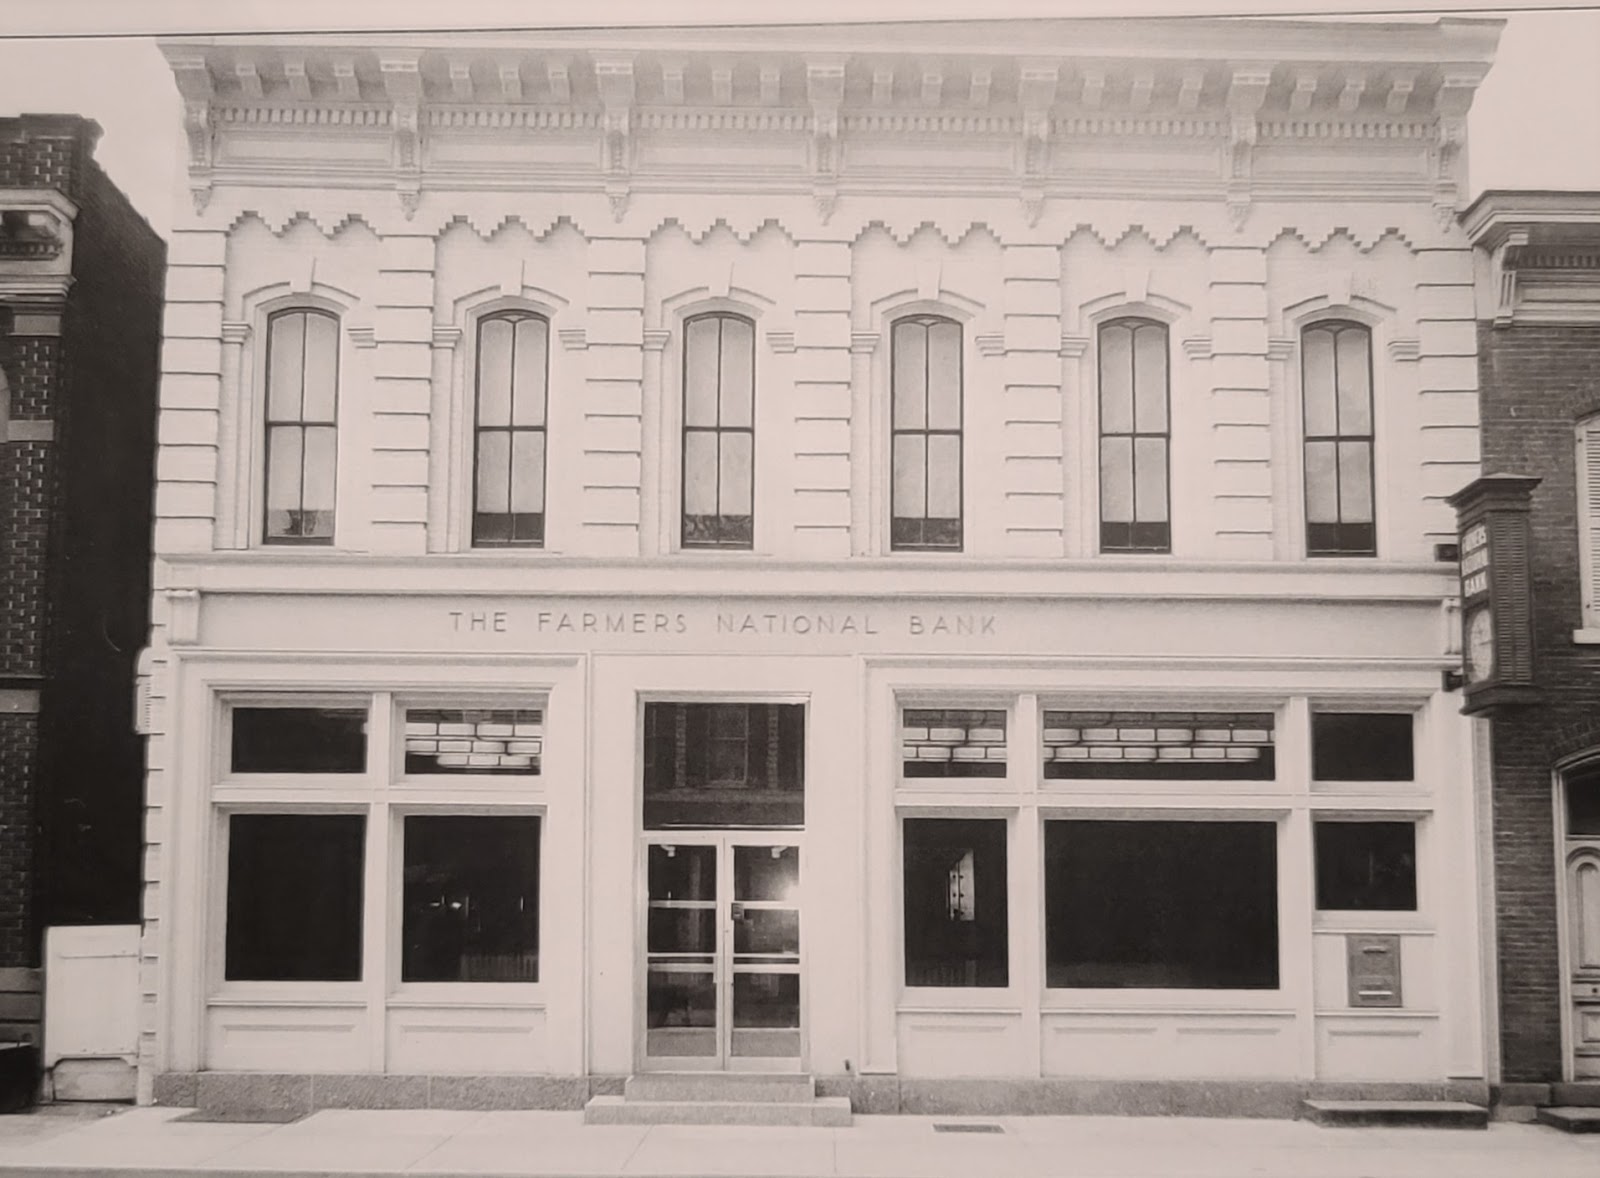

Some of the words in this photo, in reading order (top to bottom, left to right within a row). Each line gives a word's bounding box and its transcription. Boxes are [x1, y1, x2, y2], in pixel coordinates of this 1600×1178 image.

[449, 612, 508, 633] THE
[537, 612, 689, 634] FARMERS
[717, 613, 878, 635] NATIONAL
[909, 615, 997, 636] BANK
